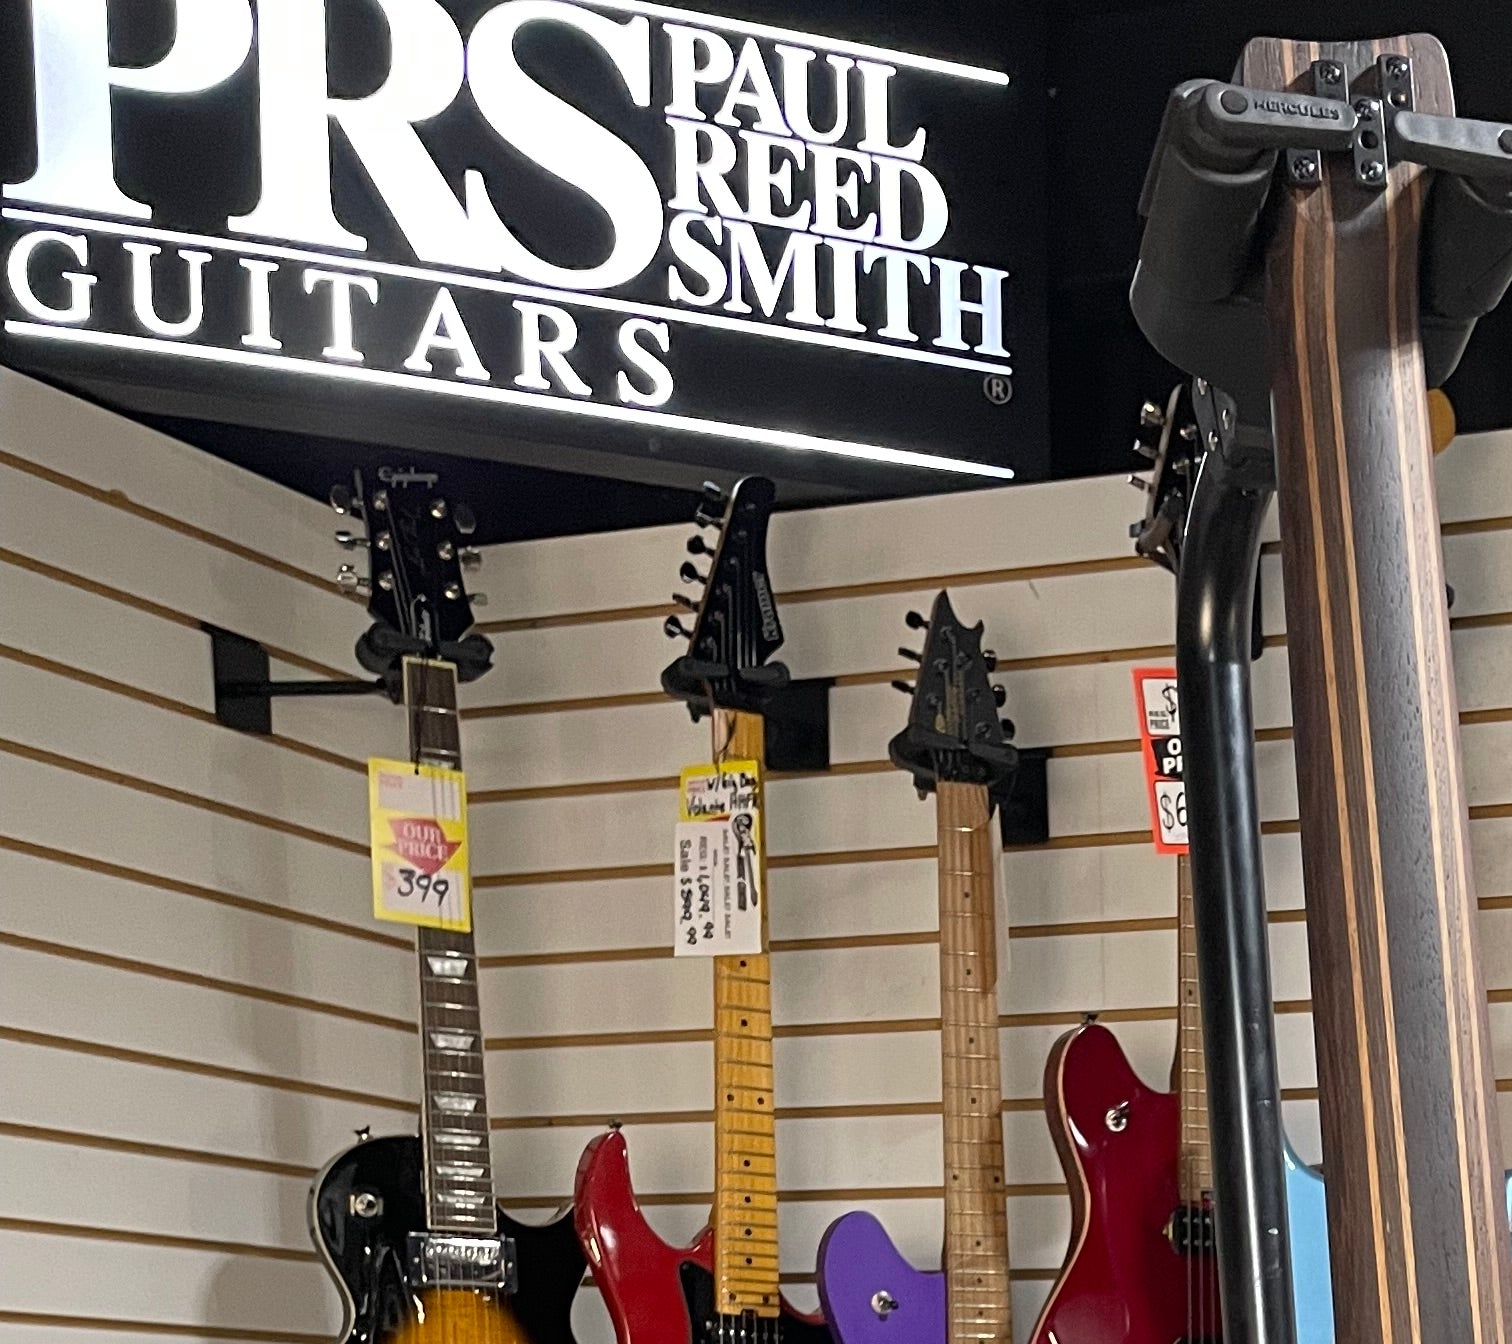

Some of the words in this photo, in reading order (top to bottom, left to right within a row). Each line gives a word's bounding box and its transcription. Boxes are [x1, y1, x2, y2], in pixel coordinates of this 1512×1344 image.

[2, 0, 663, 290] PRS
[660, 22, 926, 164] PAUL
[1254, 99, 1340, 121] HERCULES
[664, 116, 950, 246] REED
[6, 230, 676, 407] GUITARS
[666, 210, 1010, 357] SMITH
[397, 838, 448, 862] PRICE
[397, 867, 450, 907] 399
[402, 822, 442, 843] OUR
